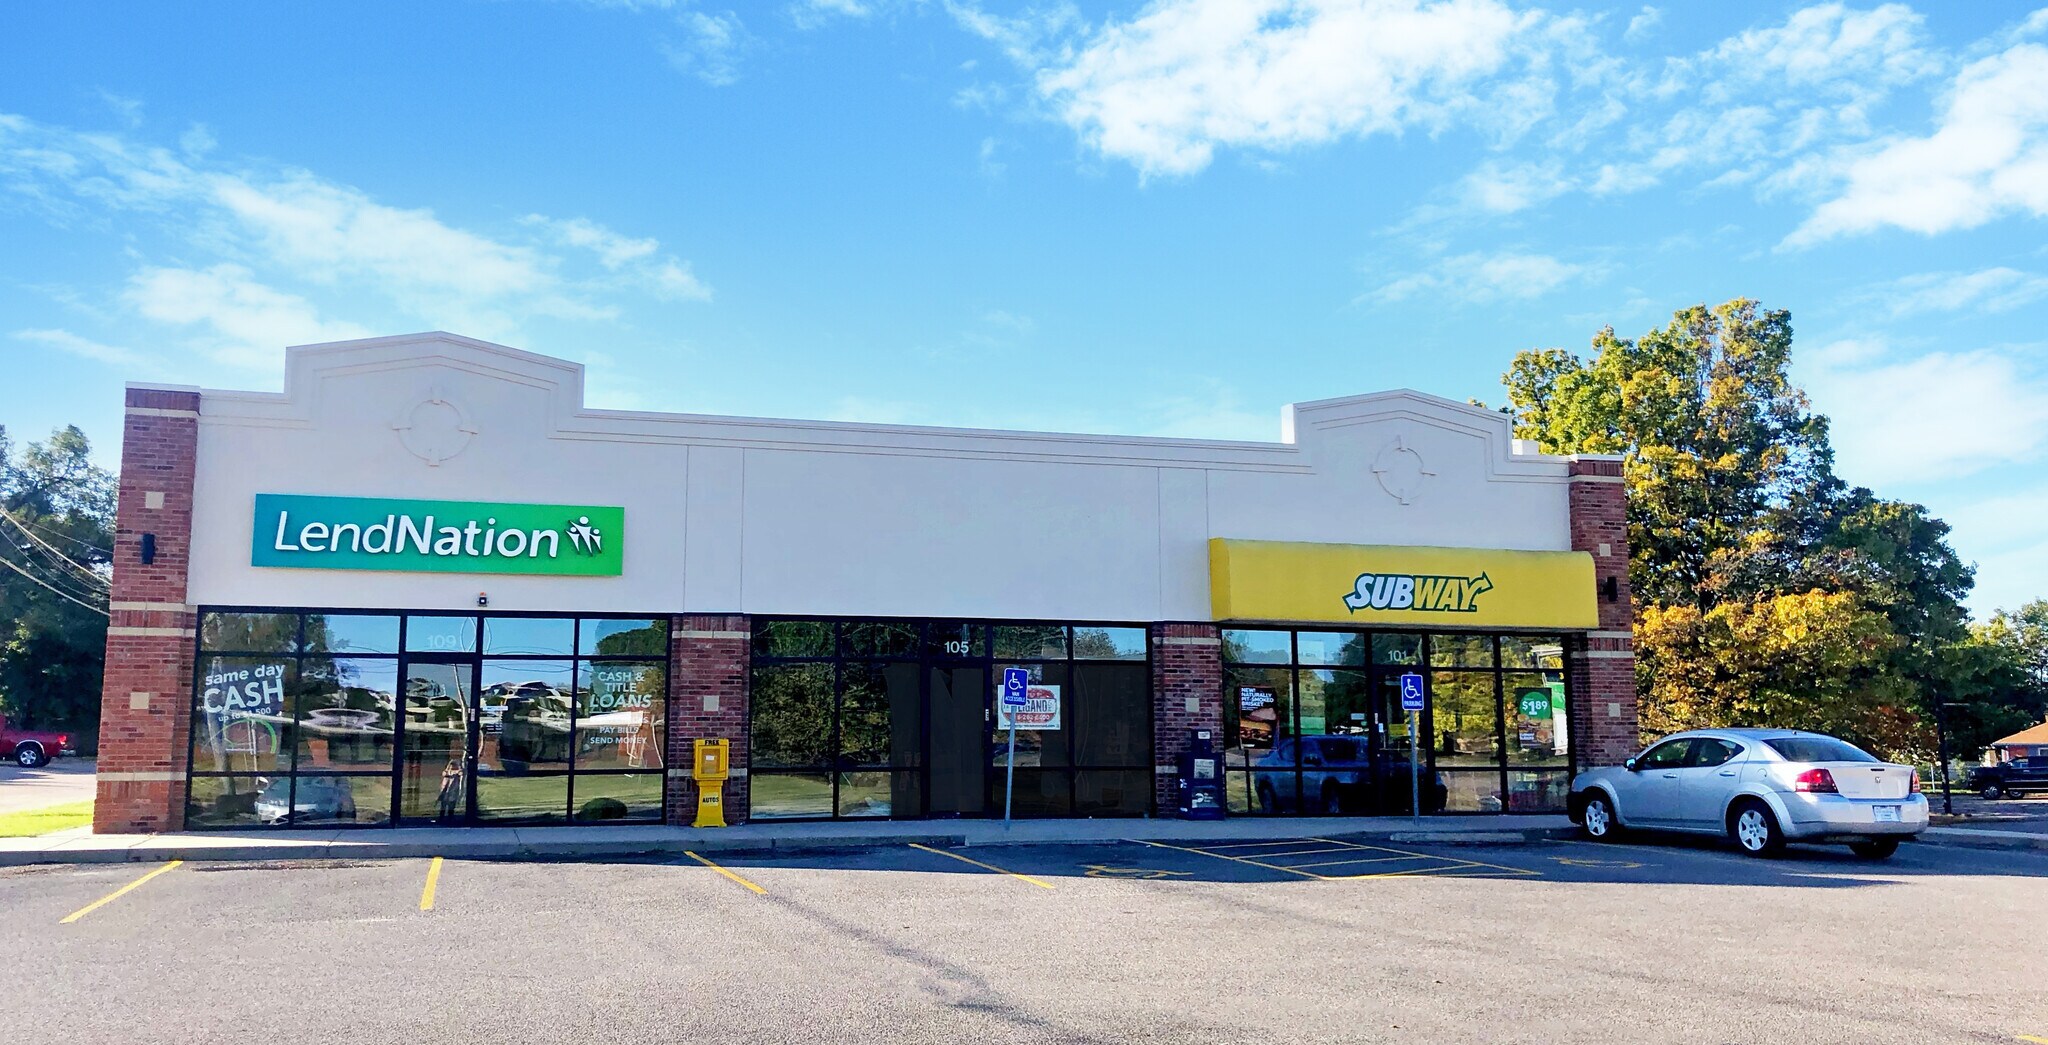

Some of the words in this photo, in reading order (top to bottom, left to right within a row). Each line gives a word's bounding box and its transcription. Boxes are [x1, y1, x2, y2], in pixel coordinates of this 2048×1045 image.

[275, 511, 559, 558] LendNation
[1343, 572, 1492, 614] SUBWAY
[427, 634, 457, 648] 109
[944, 641, 969, 654] 105
[1388, 650, 1407, 661] 101
[205, 669, 249, 686] same
[254, 664, 286, 679] day
[598, 671, 631, 682] CASH
[635, 671, 645, 682] &
[604, 682, 637, 692] TITLE
[204, 679, 285, 713] CASH
[589, 693, 653, 708] LOANS
[599, 726, 615, 734] PAY
[617, 726, 640, 734] BILLS
[590, 736, 613, 744] SEND
[615, 736, 648, 744] MONEY
